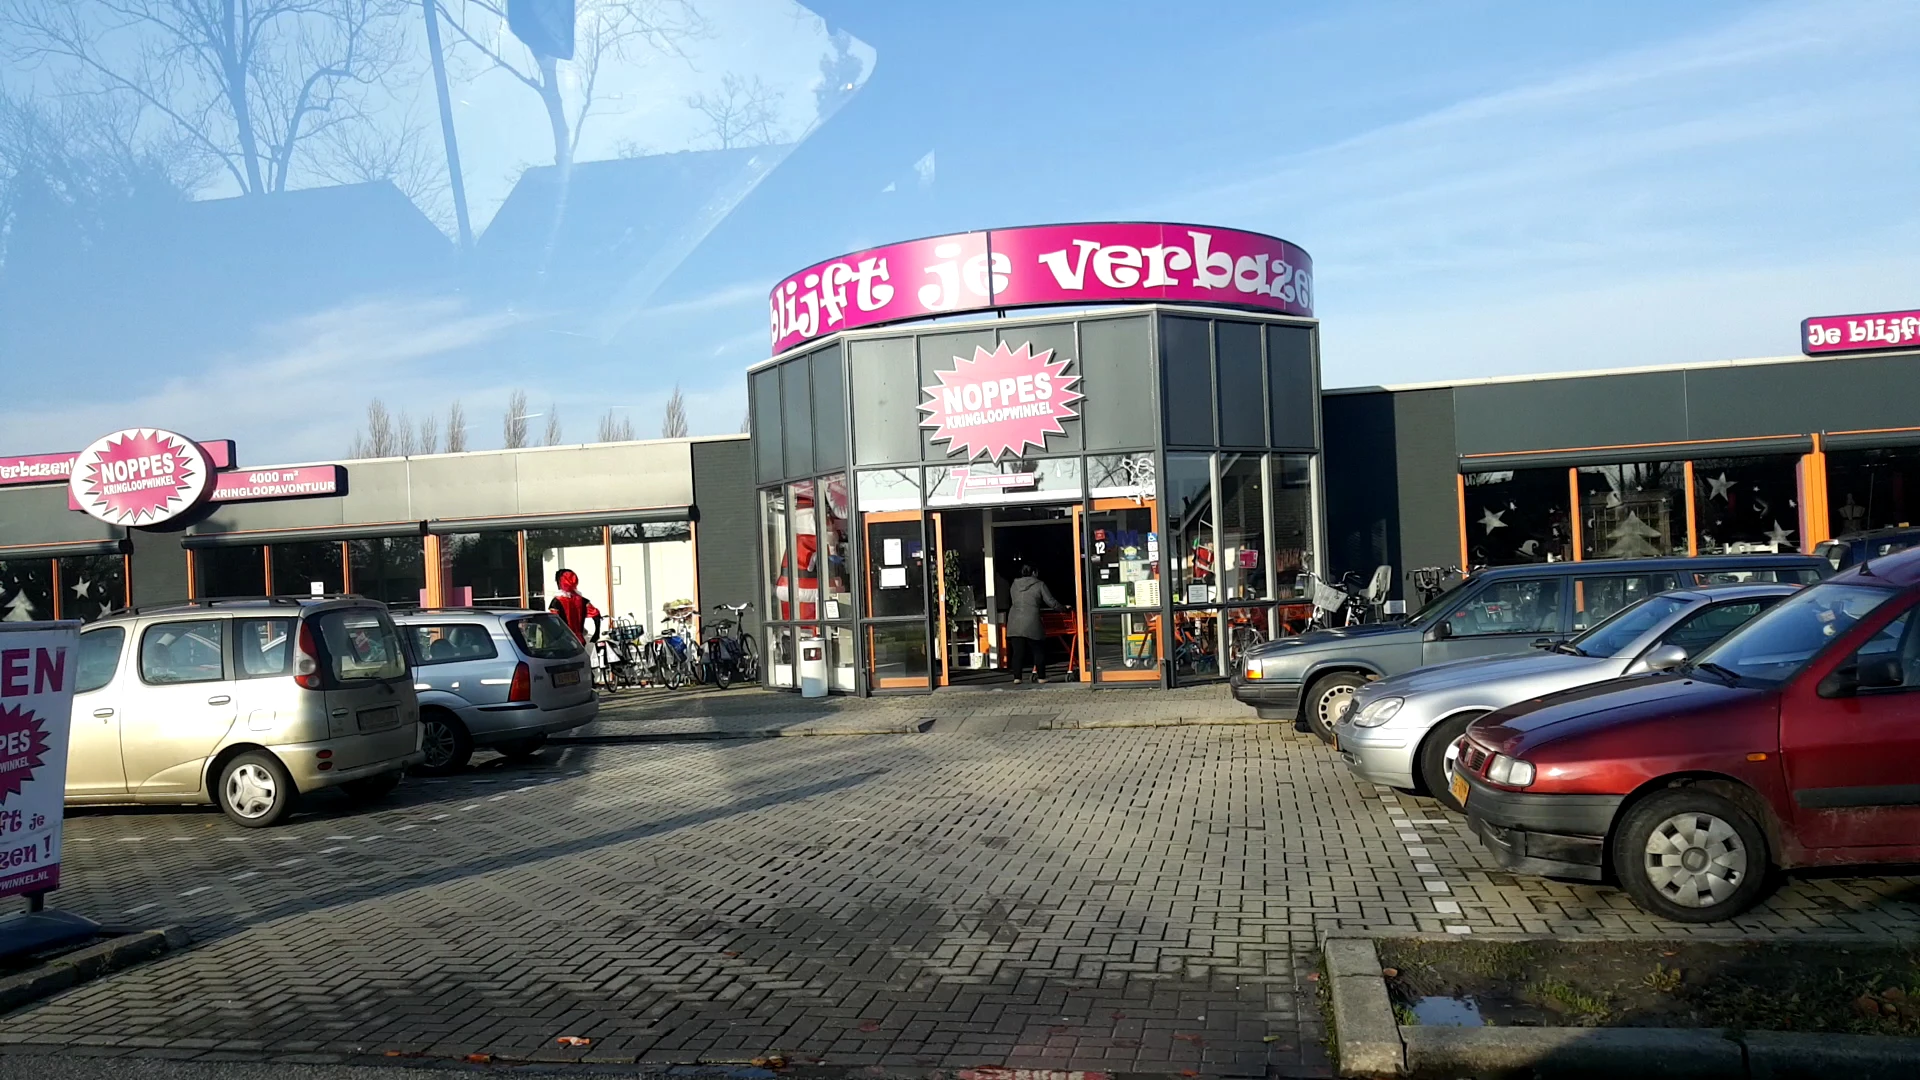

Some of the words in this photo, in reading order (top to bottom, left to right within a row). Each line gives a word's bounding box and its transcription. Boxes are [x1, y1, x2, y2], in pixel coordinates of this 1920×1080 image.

[770, 257, 895, 346] blijft
[918, 243, 1012, 311] je
[1808, 324, 1842, 346] Je
[1847, 316, 1920, 344] blijf
[943, 372, 1053, 414] NOPPES
[946, 401, 1054, 430] KRINGLOOPWINKEL
[0, 457, 75, 479] erbazen!
[101, 452, 175, 483] NOPPES
[249, 471, 279, 484] 4000
[103, 475, 175, 496] KRINGLOOPWINKEL
[213, 481, 336, 499] KRINGLOOPAVONTUUR
[951, 469, 969, 500] 7
[1095, 541, 1106, 555] 12
[1, 646, 66, 698] EN
[29, 813, 45, 831] je
[0, 870, 49, 891] WINKEL.NL
